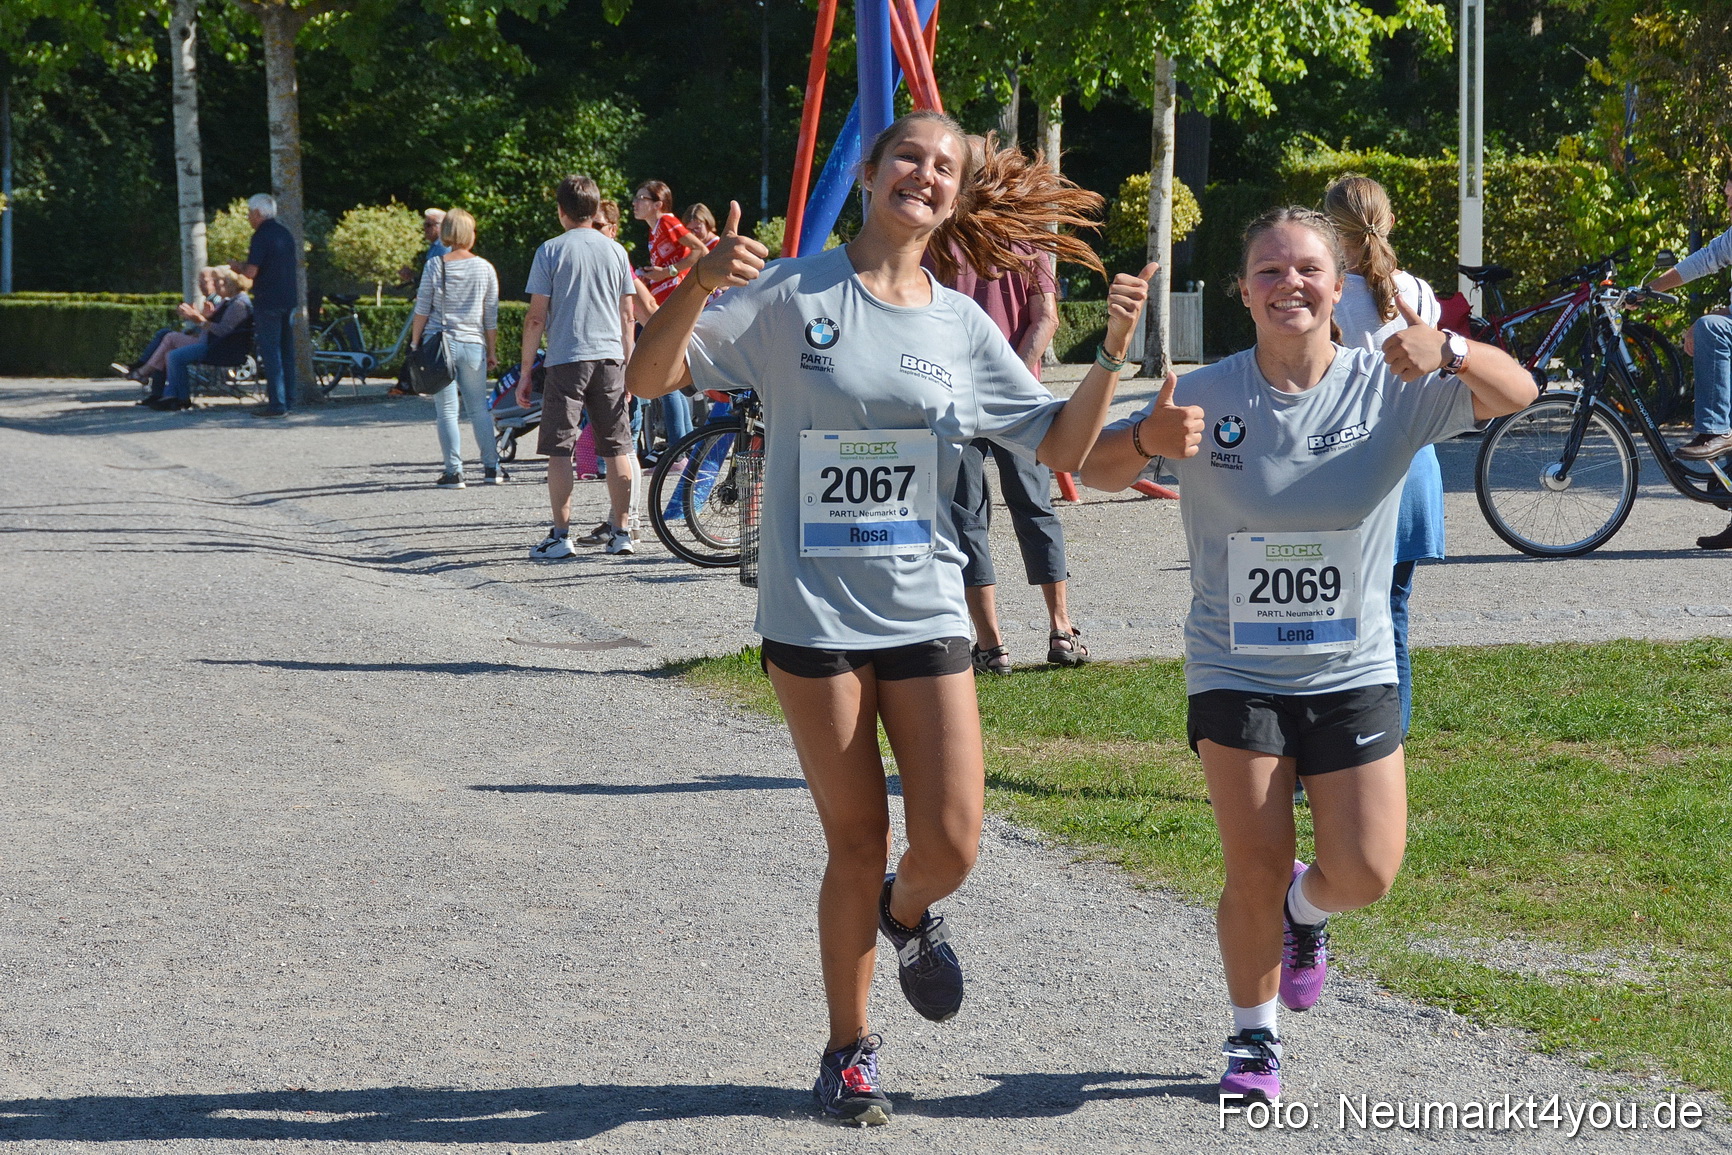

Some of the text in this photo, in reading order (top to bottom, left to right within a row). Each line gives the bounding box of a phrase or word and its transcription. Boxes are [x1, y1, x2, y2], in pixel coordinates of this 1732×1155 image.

[1535, 302, 1575, 357] ROCKY MOUNTAIN
[800, 352, 835, 367] PARTL
[800, 362, 835, 373] Neumarkt
[900, 353, 953, 388] BOCK
[1307, 420, 1370, 450] BOCK
[840, 441, 898, 455] BOCK
[1210, 451, 1244, 464] PARTL
[1210, 460, 1243, 471] Neumarkt
[820, 465, 916, 504] 2067
[829, 509, 897, 518] PARTL Neumarkt
[849, 527, 888, 543] Rosa
[1265, 543, 1323, 557] BOCK
[1248, 565, 1341, 604] 2069
[1257, 609, 1324, 618] PARTL Neumarkt
[1277, 626, 1315, 642] Lena
